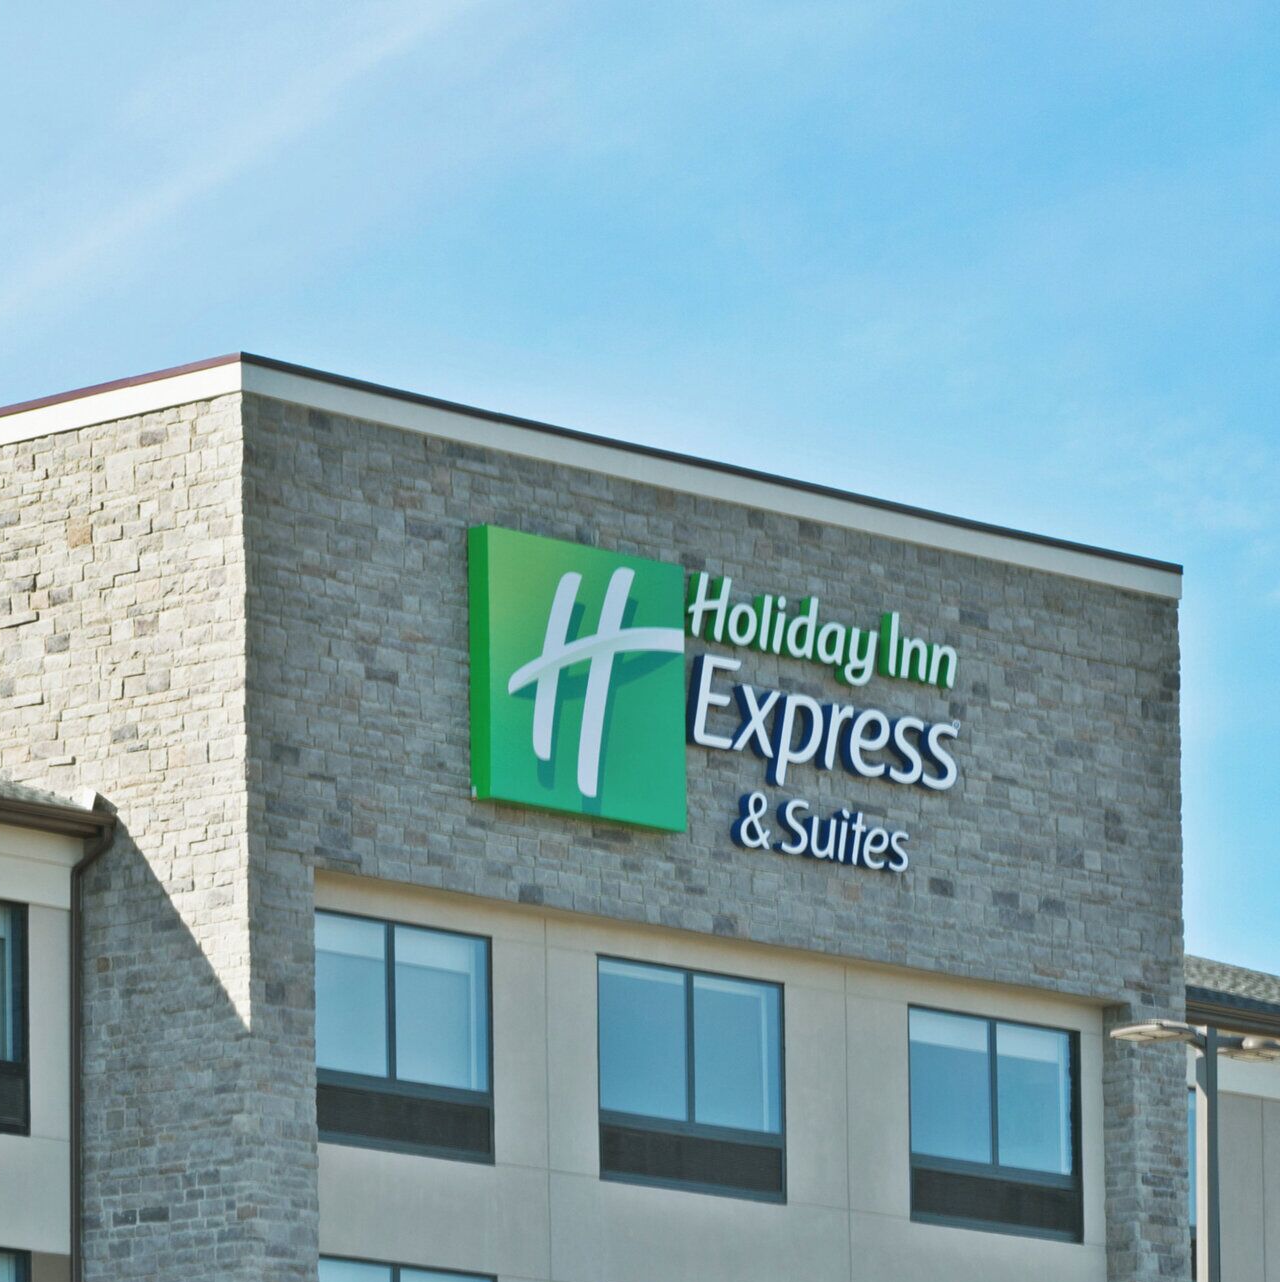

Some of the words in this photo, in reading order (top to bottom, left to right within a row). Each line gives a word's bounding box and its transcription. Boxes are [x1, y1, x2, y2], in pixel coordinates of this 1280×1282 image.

[688, 571, 878, 687] Holiday
[886, 611, 958, 689] Inn
[692, 653, 959, 791] Express
[739, 791, 771, 850] &
[779, 799, 910, 873] Suites
